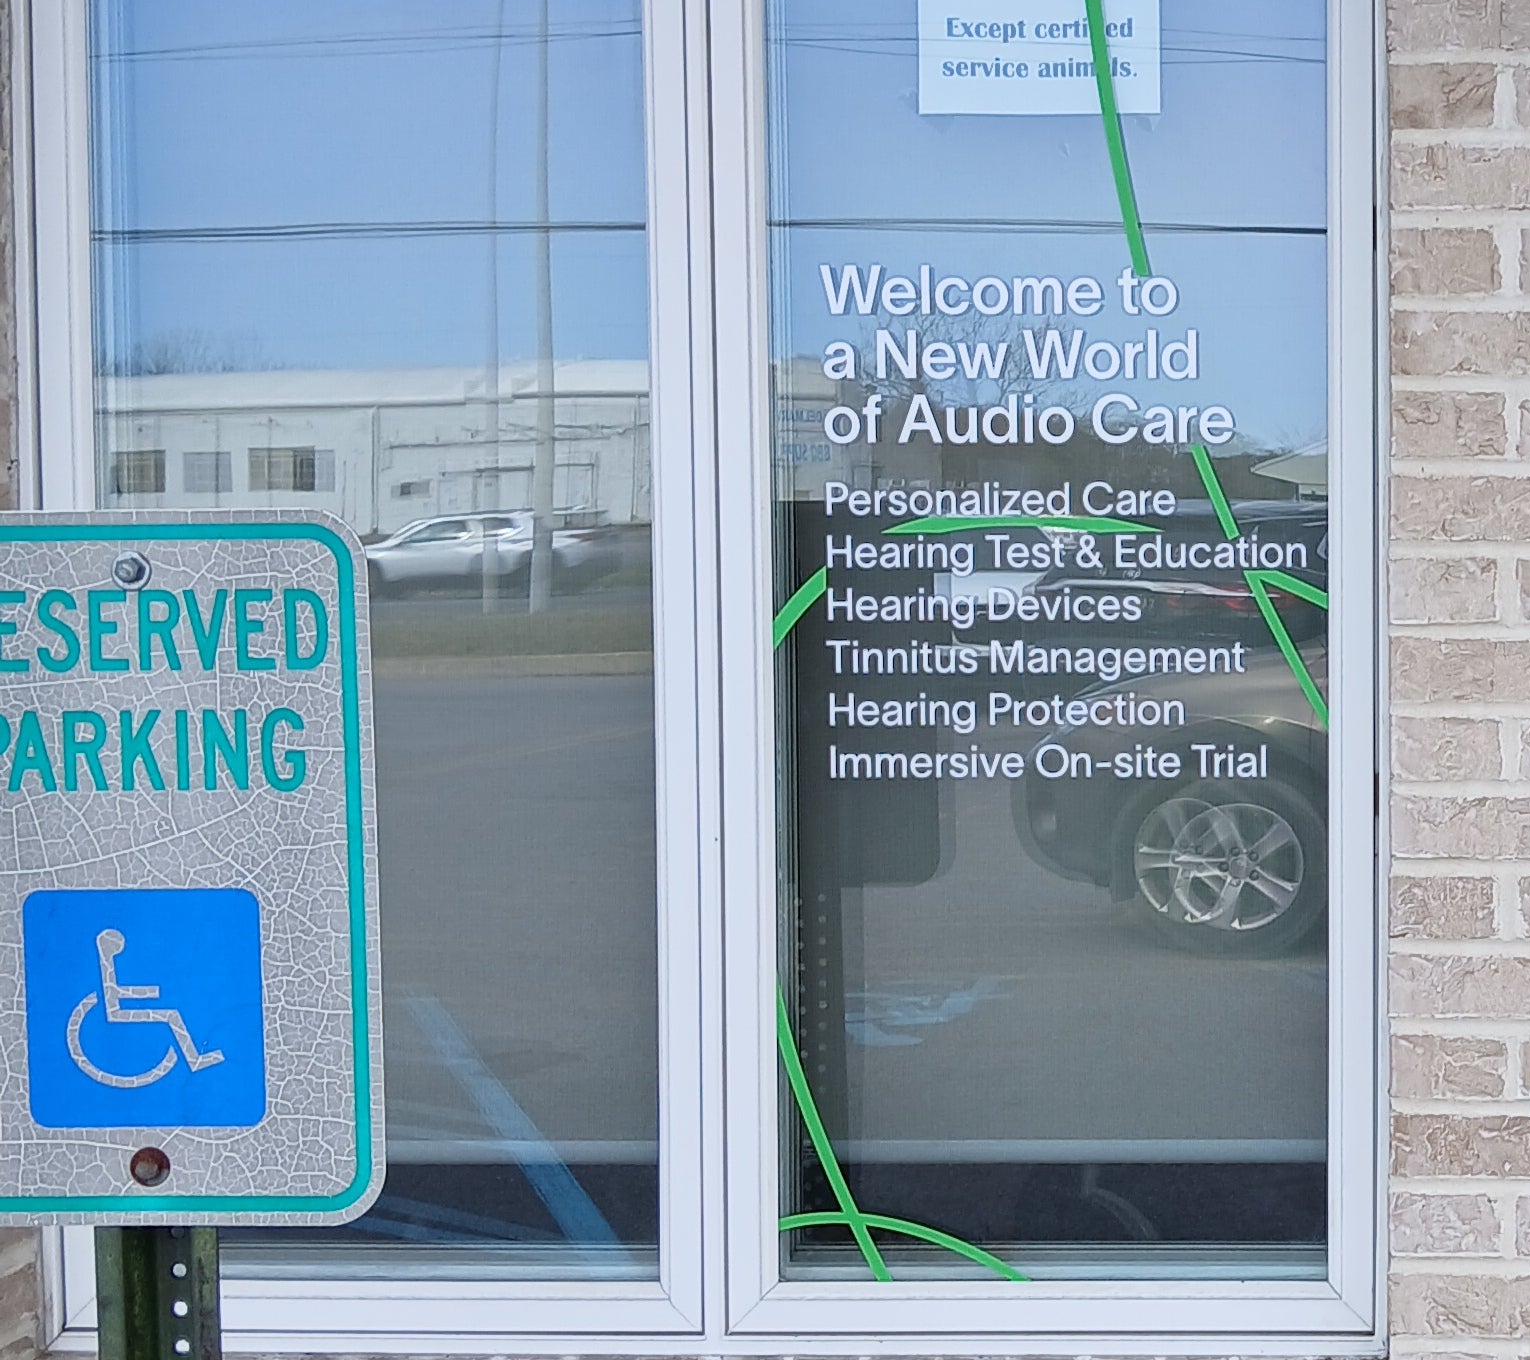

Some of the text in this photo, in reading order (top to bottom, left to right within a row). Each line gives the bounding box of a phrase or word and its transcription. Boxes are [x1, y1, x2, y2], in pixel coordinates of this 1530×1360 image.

[946, 17, 1133, 43] Except certied
[942, 56, 1138, 78] service animls.
[821, 265, 1178, 316] Welcome to
[824, 330, 1199, 381] a New World
[824, 394, 1235, 445] of Audio Care
[826, 482, 1177, 517] Personalized Care
[827, 536, 1308, 576] Hearing Test & Education
[828, 588, 1143, 627] Hearing Devices
[827, 640, 1246, 682] Tinnitus Management
[830, 693, 1186, 735] Hearing Protection
[0, 708, 307, 793] ARKING
[830, 745, 1269, 779] Immersive On-site Trial
